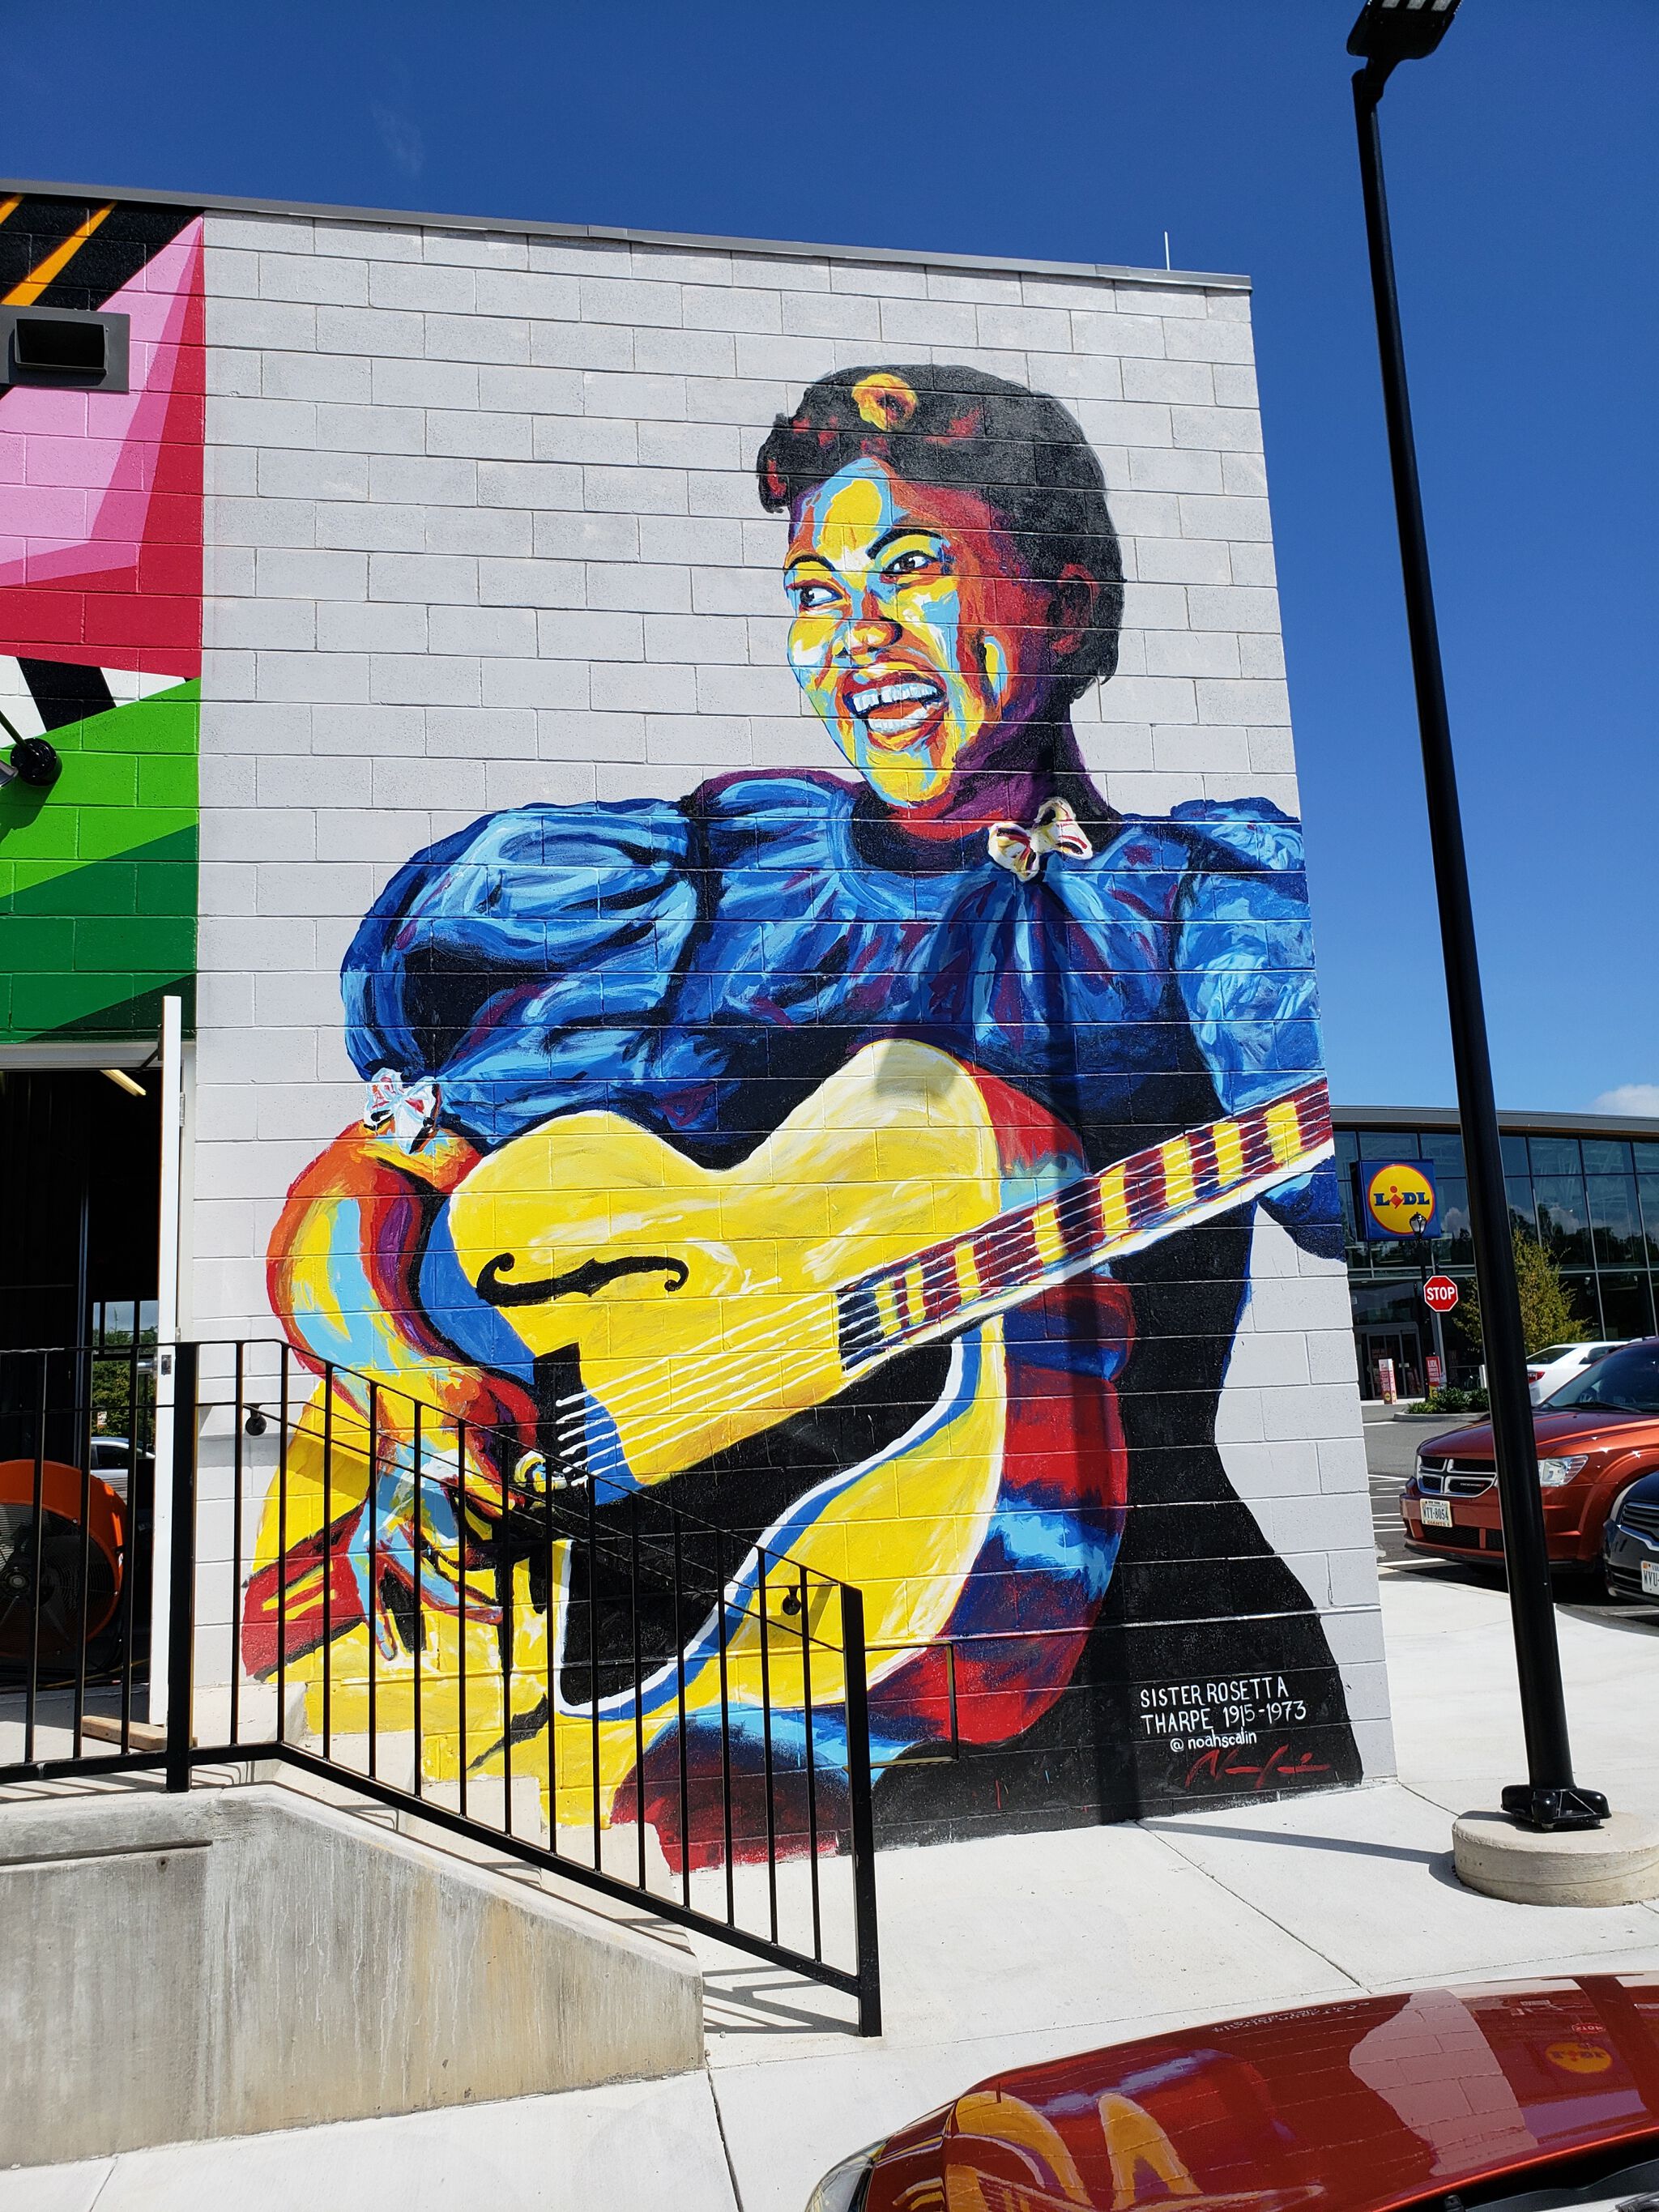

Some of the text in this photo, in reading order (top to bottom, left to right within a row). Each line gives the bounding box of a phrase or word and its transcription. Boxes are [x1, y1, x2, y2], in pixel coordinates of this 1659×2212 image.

[1427, 1286, 1456, 1301] STOP
[1140, 1676, 1289, 1708] SISTER ROSETTA
[1141, 1700, 1307, 1734] THARPE 1915-1973
